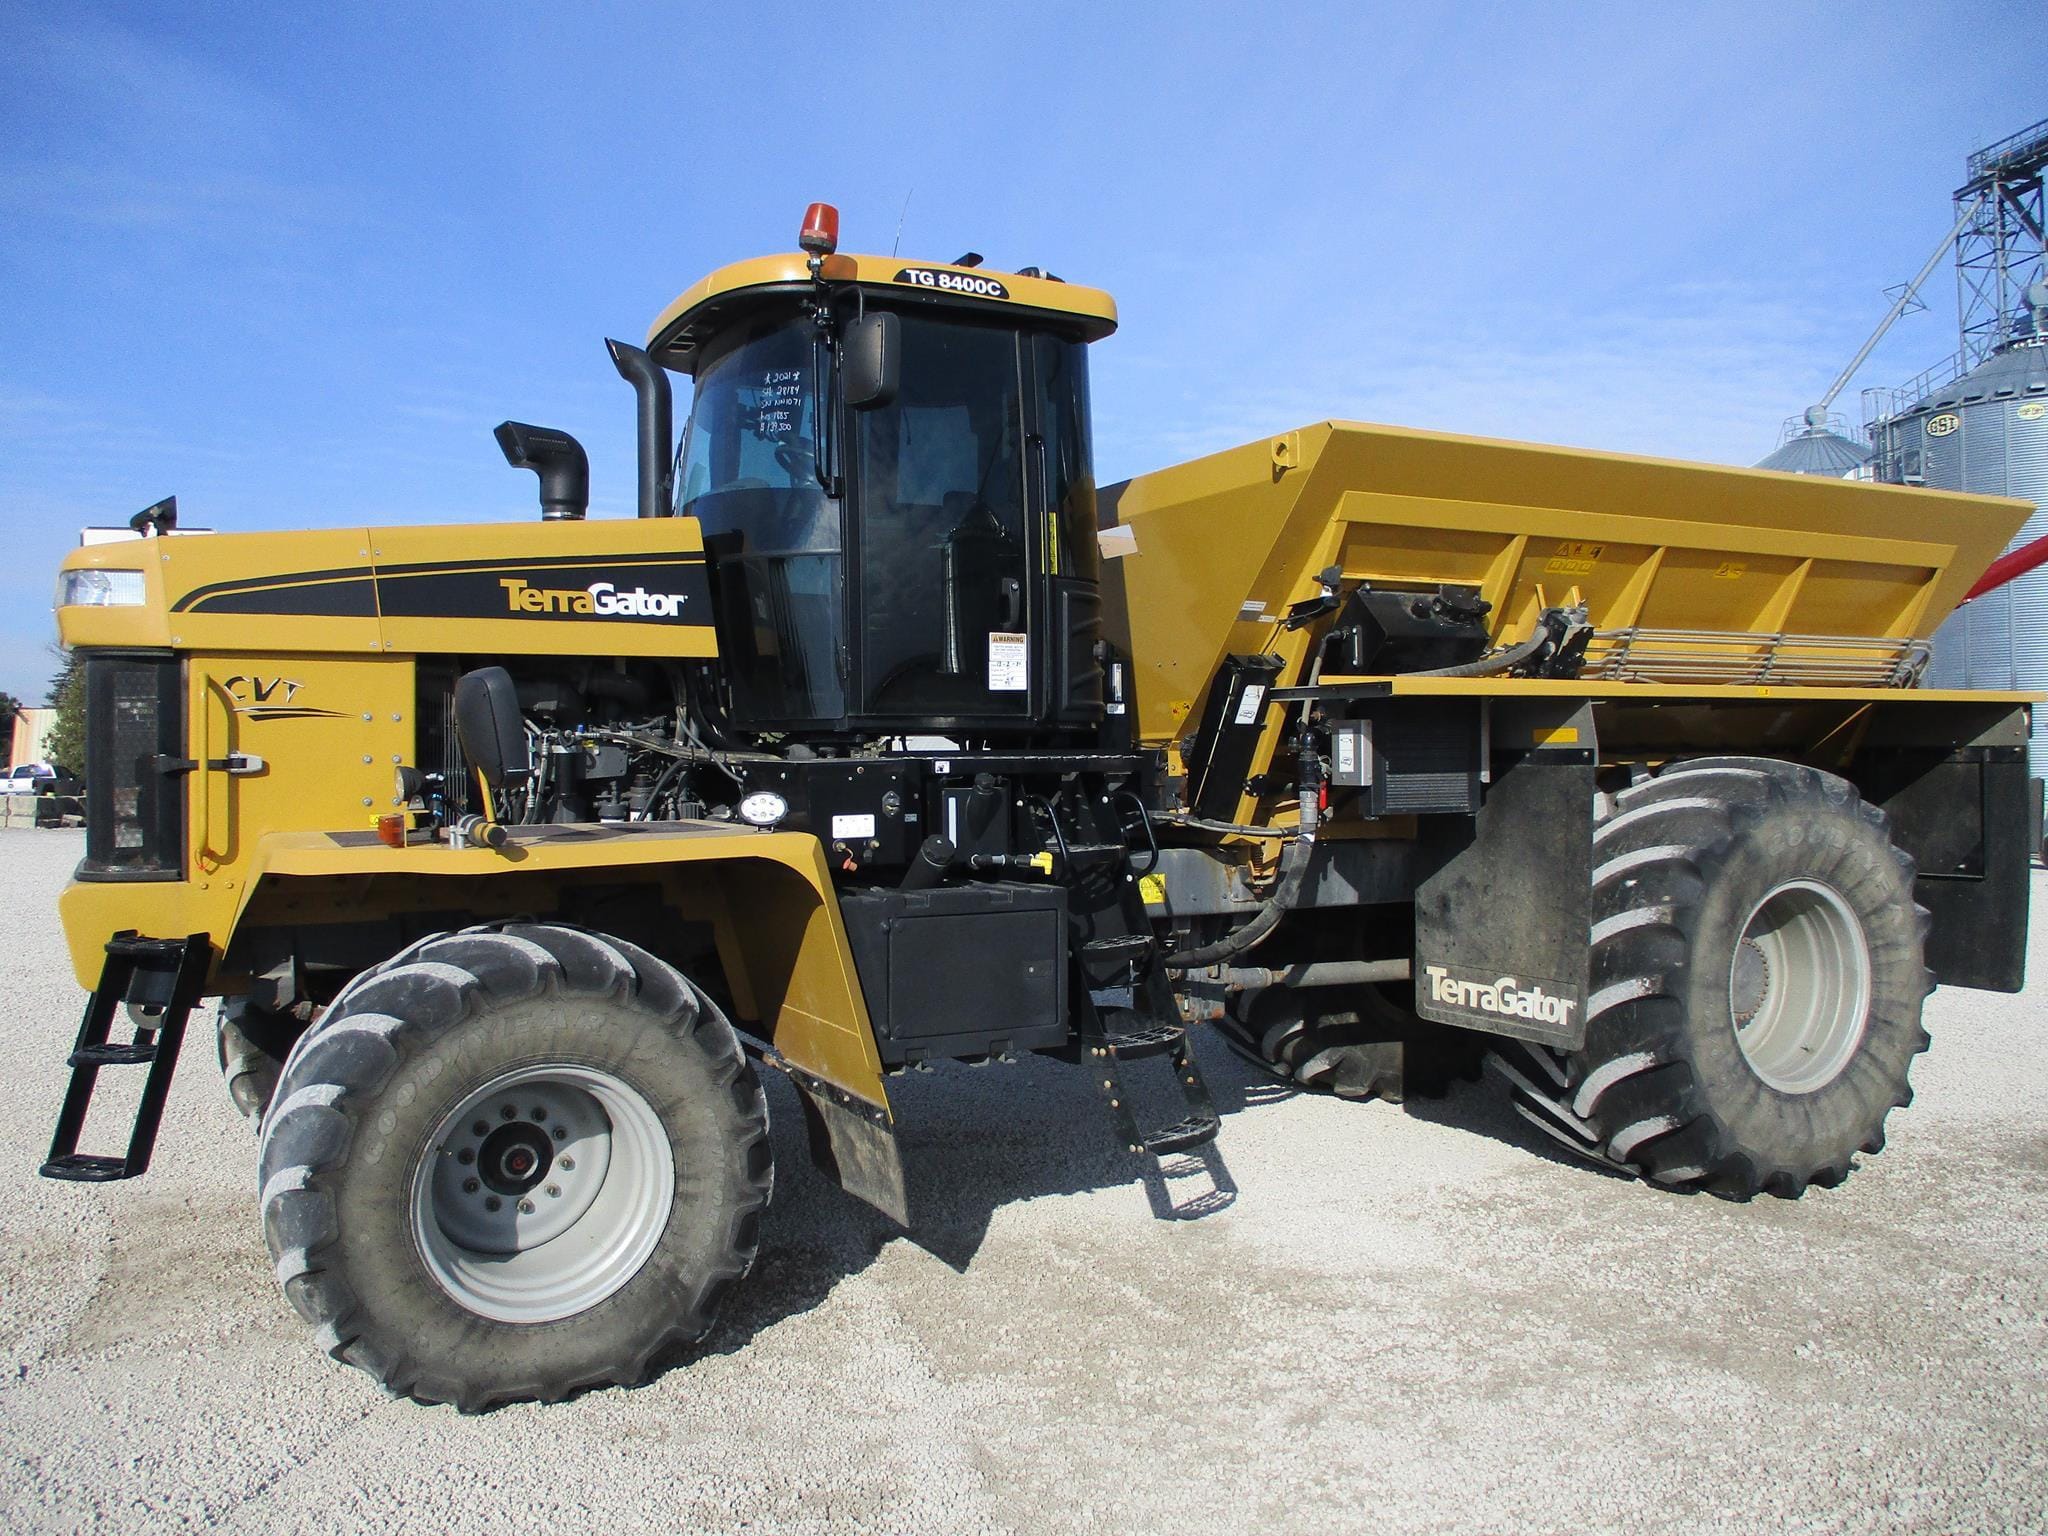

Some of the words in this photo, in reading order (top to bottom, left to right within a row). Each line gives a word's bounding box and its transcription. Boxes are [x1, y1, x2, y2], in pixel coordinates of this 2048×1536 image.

[906, 269, 934, 286] TG
[938, 273, 1001, 296] 8400C
[1929, 417, 1956, 433] GSI
[500, 578, 685, 617] TerraGator
[998, 635, 1024, 643] WARNING
[223, 675, 304, 703] CVT
[1426, 965, 1575, 1026] TerraGator
[364, 1007, 607, 1165] GOODYEAR
